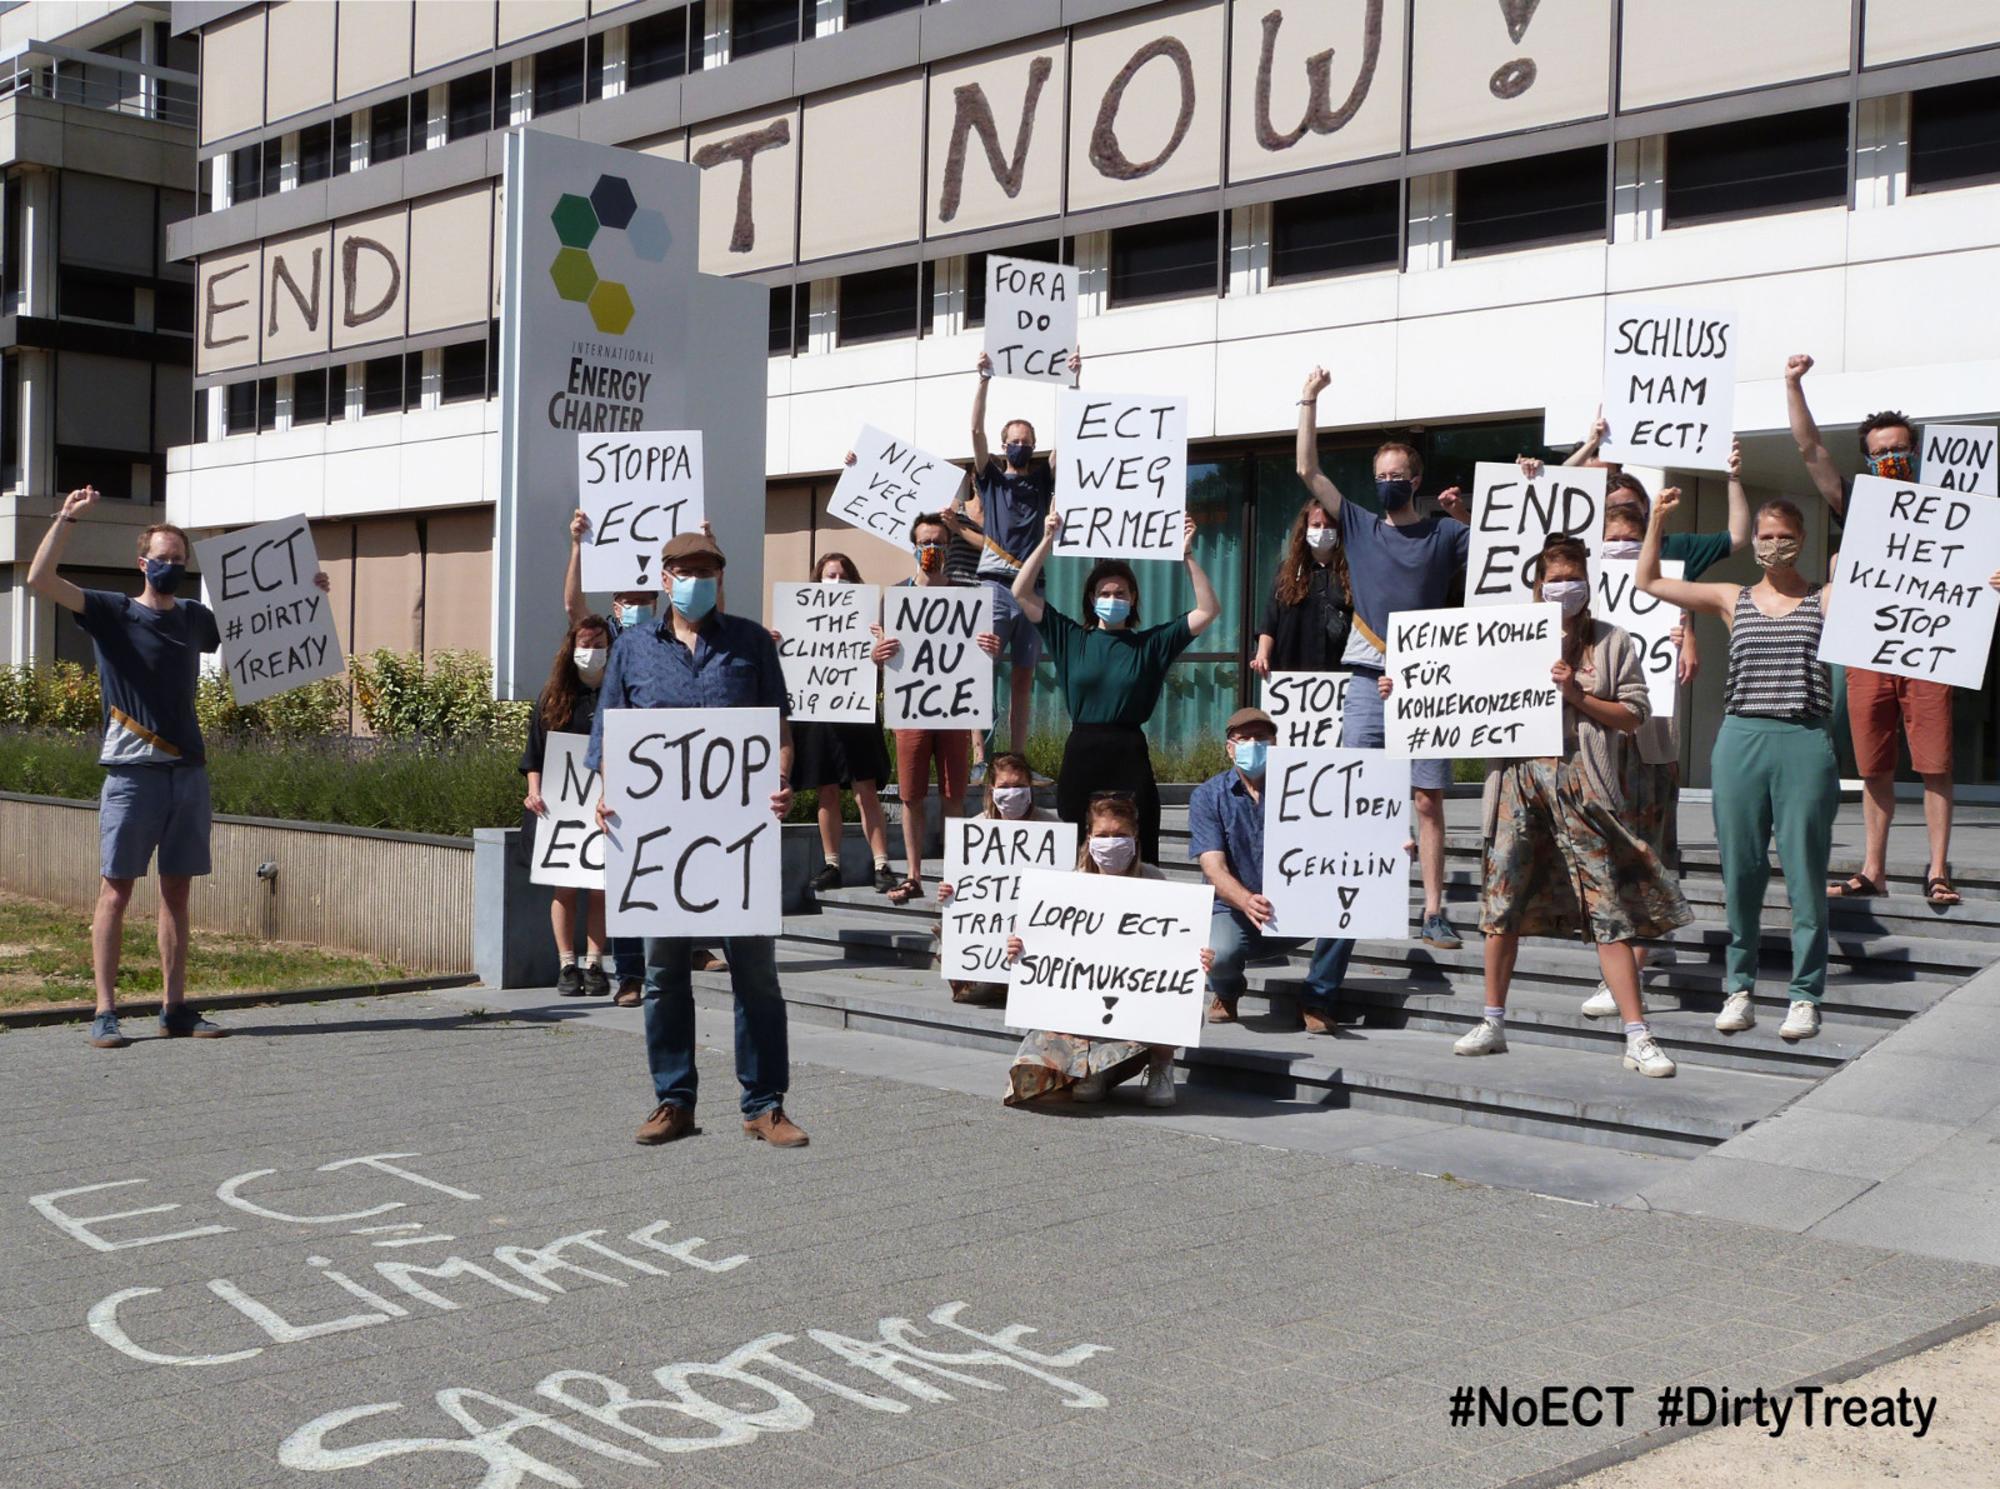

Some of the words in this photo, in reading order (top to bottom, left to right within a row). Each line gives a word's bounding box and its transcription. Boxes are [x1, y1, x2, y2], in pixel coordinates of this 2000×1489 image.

[204, 235, 401, 349] END
[995, 263, 1065, 302] FORA
[571, 341, 654, 365] INTERNATIONAL
[1614, 317, 1730, 359] SCHLUSS
[998, 344, 1068, 376] TCE
[567, 357, 652, 403] ENERGY
[1629, 374, 1707, 405] MAM
[548, 391, 644, 432] CHARTER
[1077, 402, 1175, 440] ECT
[1630, 420, 1708, 453] ECT!
[1926, 436, 1993, 469] NON
[586, 442, 692, 484] STOPPA
[1940, 469, 1979, 493] AU
[595, 499, 688, 546] ECT
[1058, 507, 1181, 548] ERMEE
[1479, 482, 1596, 536] END
[1889, 490, 1970, 531] RED
[221, 527, 305, 601] ECT
[1475, 545, 1590, 595] EC
[1886, 532, 1964, 569] HET
[796, 588, 856, 607] SAVE
[1849, 560, 1983, 608] KLIMAAT
[806, 611, 860, 633] THE
[895, 596, 982, 638] NON
[1398, 622, 1469, 653] KEINE
[1477, 619, 1548, 647] KOHLE
[1873, 604, 1951, 637] STOP
[234, 635, 327, 684] TREATY
[779, 637, 871, 660] CLIMATE
[912, 639, 964, 676] AU
[1871, 640, 1957, 673] ECT
[807, 665, 857, 686] NOT
[1401, 660, 1451, 689] FÜR
[895, 677, 979, 720] T.C.E.
[1397, 689, 1556, 720] KOHLEKONZERNE
[1471, 722, 1525, 747] ECT
[626, 728, 771, 807] STOP
[541, 820, 605, 871] EC
[962, 823, 1055, 866] PARA
[618, 822, 768, 913] ECT
[952, 912, 1018, 935] TRAT
[1028, 900, 1104, 936] LOPPU
[29, 1153, 482, 1252] ECT
[278, 1300, 1114, 1489] SABOTAGE
